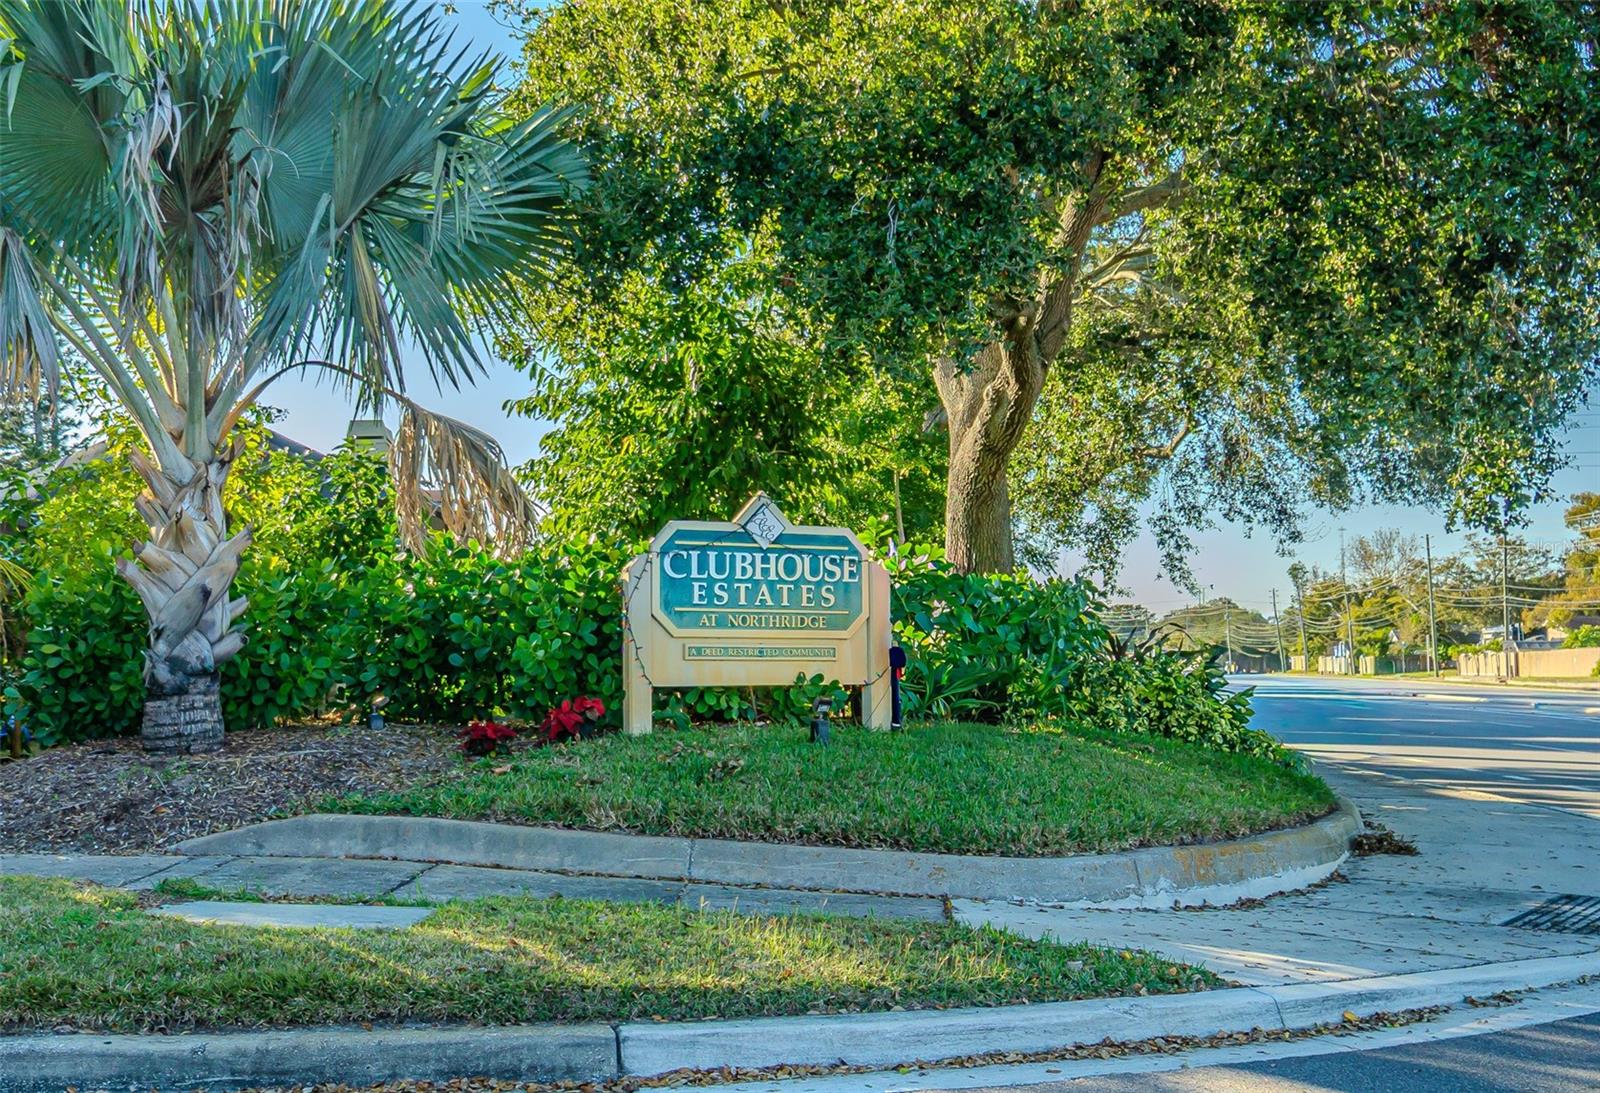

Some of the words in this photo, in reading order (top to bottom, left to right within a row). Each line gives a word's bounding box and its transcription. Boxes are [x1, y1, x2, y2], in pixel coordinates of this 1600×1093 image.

[663, 550, 859, 583] CLUBHOUSE
[692, 581, 836, 607] ESTATES
[699, 614, 718, 627] AT
[728, 614, 827, 628] NORTHRIDGE
[689, 648, 697, 656] A
[702, 648, 724, 657] DEED
[728, 648, 778, 657] RESTRICTED
[782, 649, 835, 658] COMMUNITY
